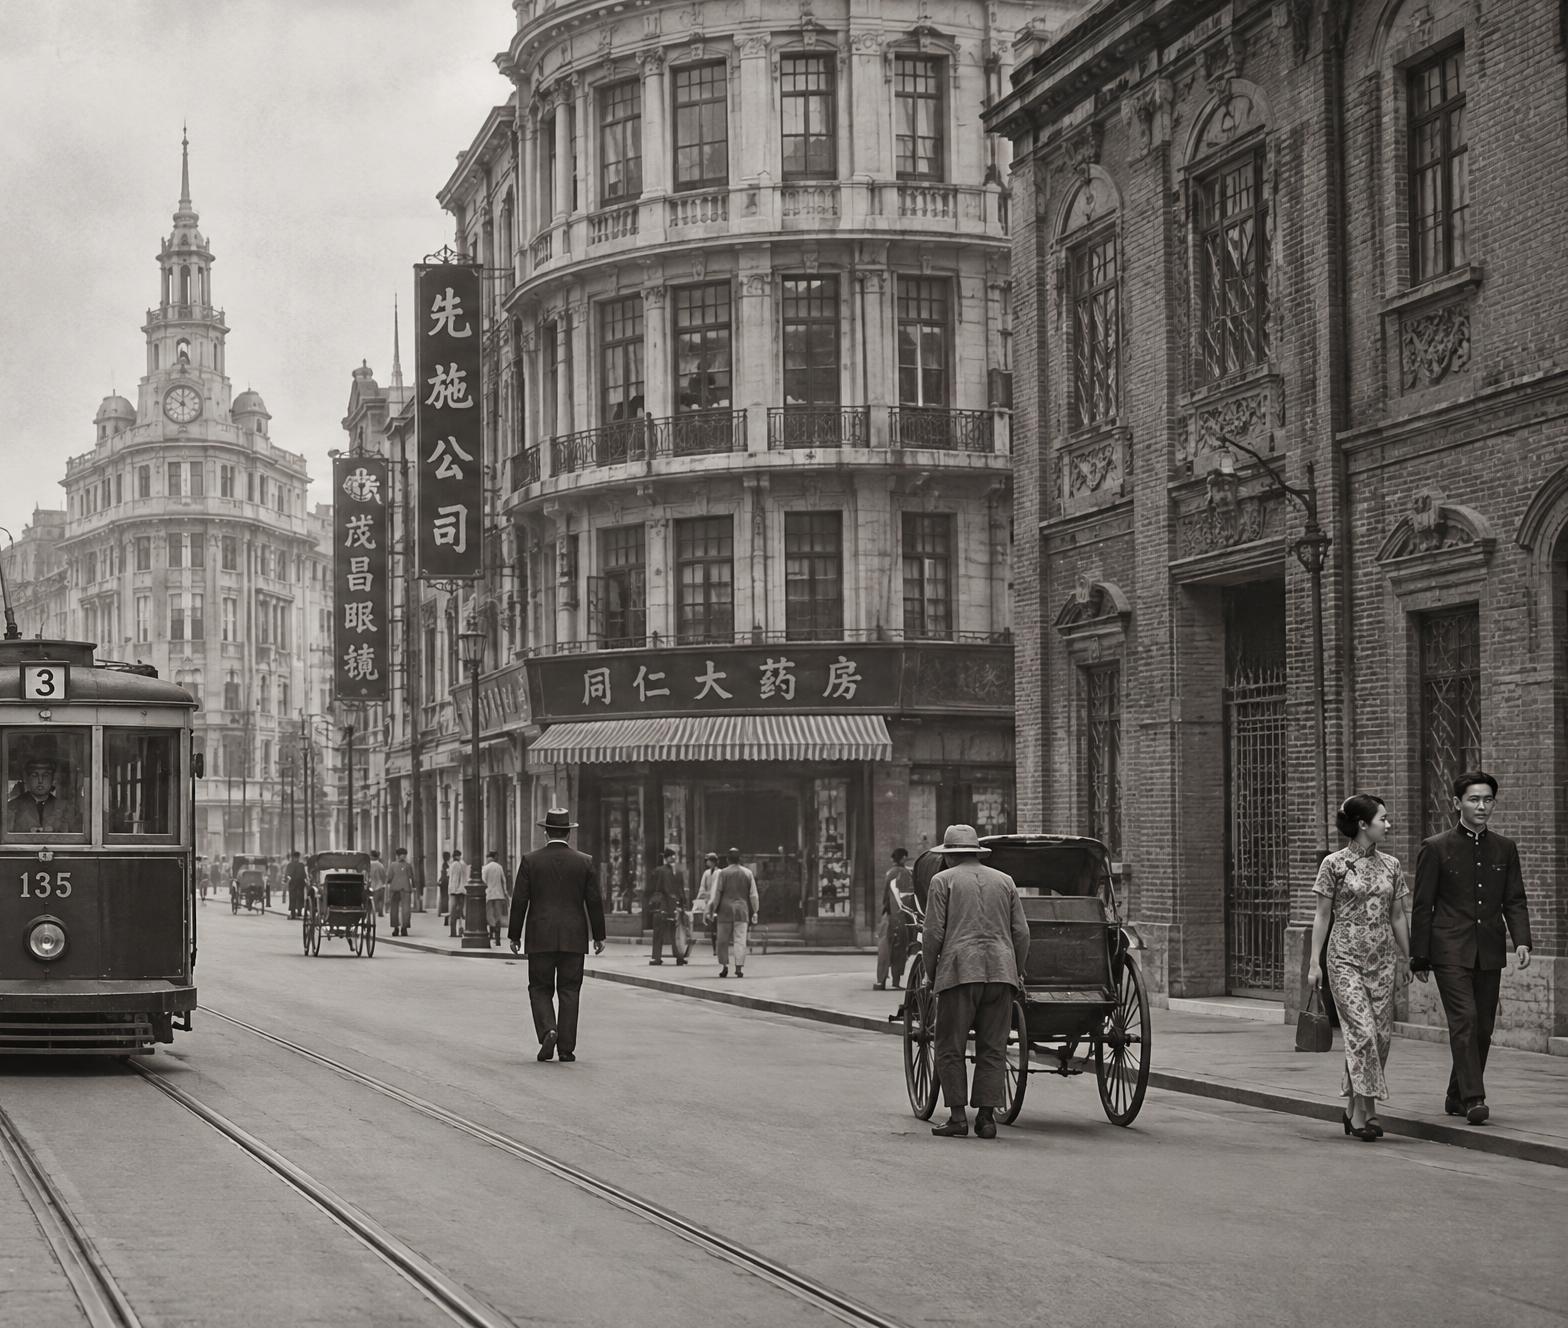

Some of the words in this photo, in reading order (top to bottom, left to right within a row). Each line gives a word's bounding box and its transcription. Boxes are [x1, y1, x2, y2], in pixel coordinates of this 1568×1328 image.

[424, 287, 474, 553] 先施公司
[344, 514, 379, 681] 茂昌眼镜
[35, 669, 55, 697] 3
[582, 656, 862, 705] 同仁大药房
[20, 872, 72, 898] 135
